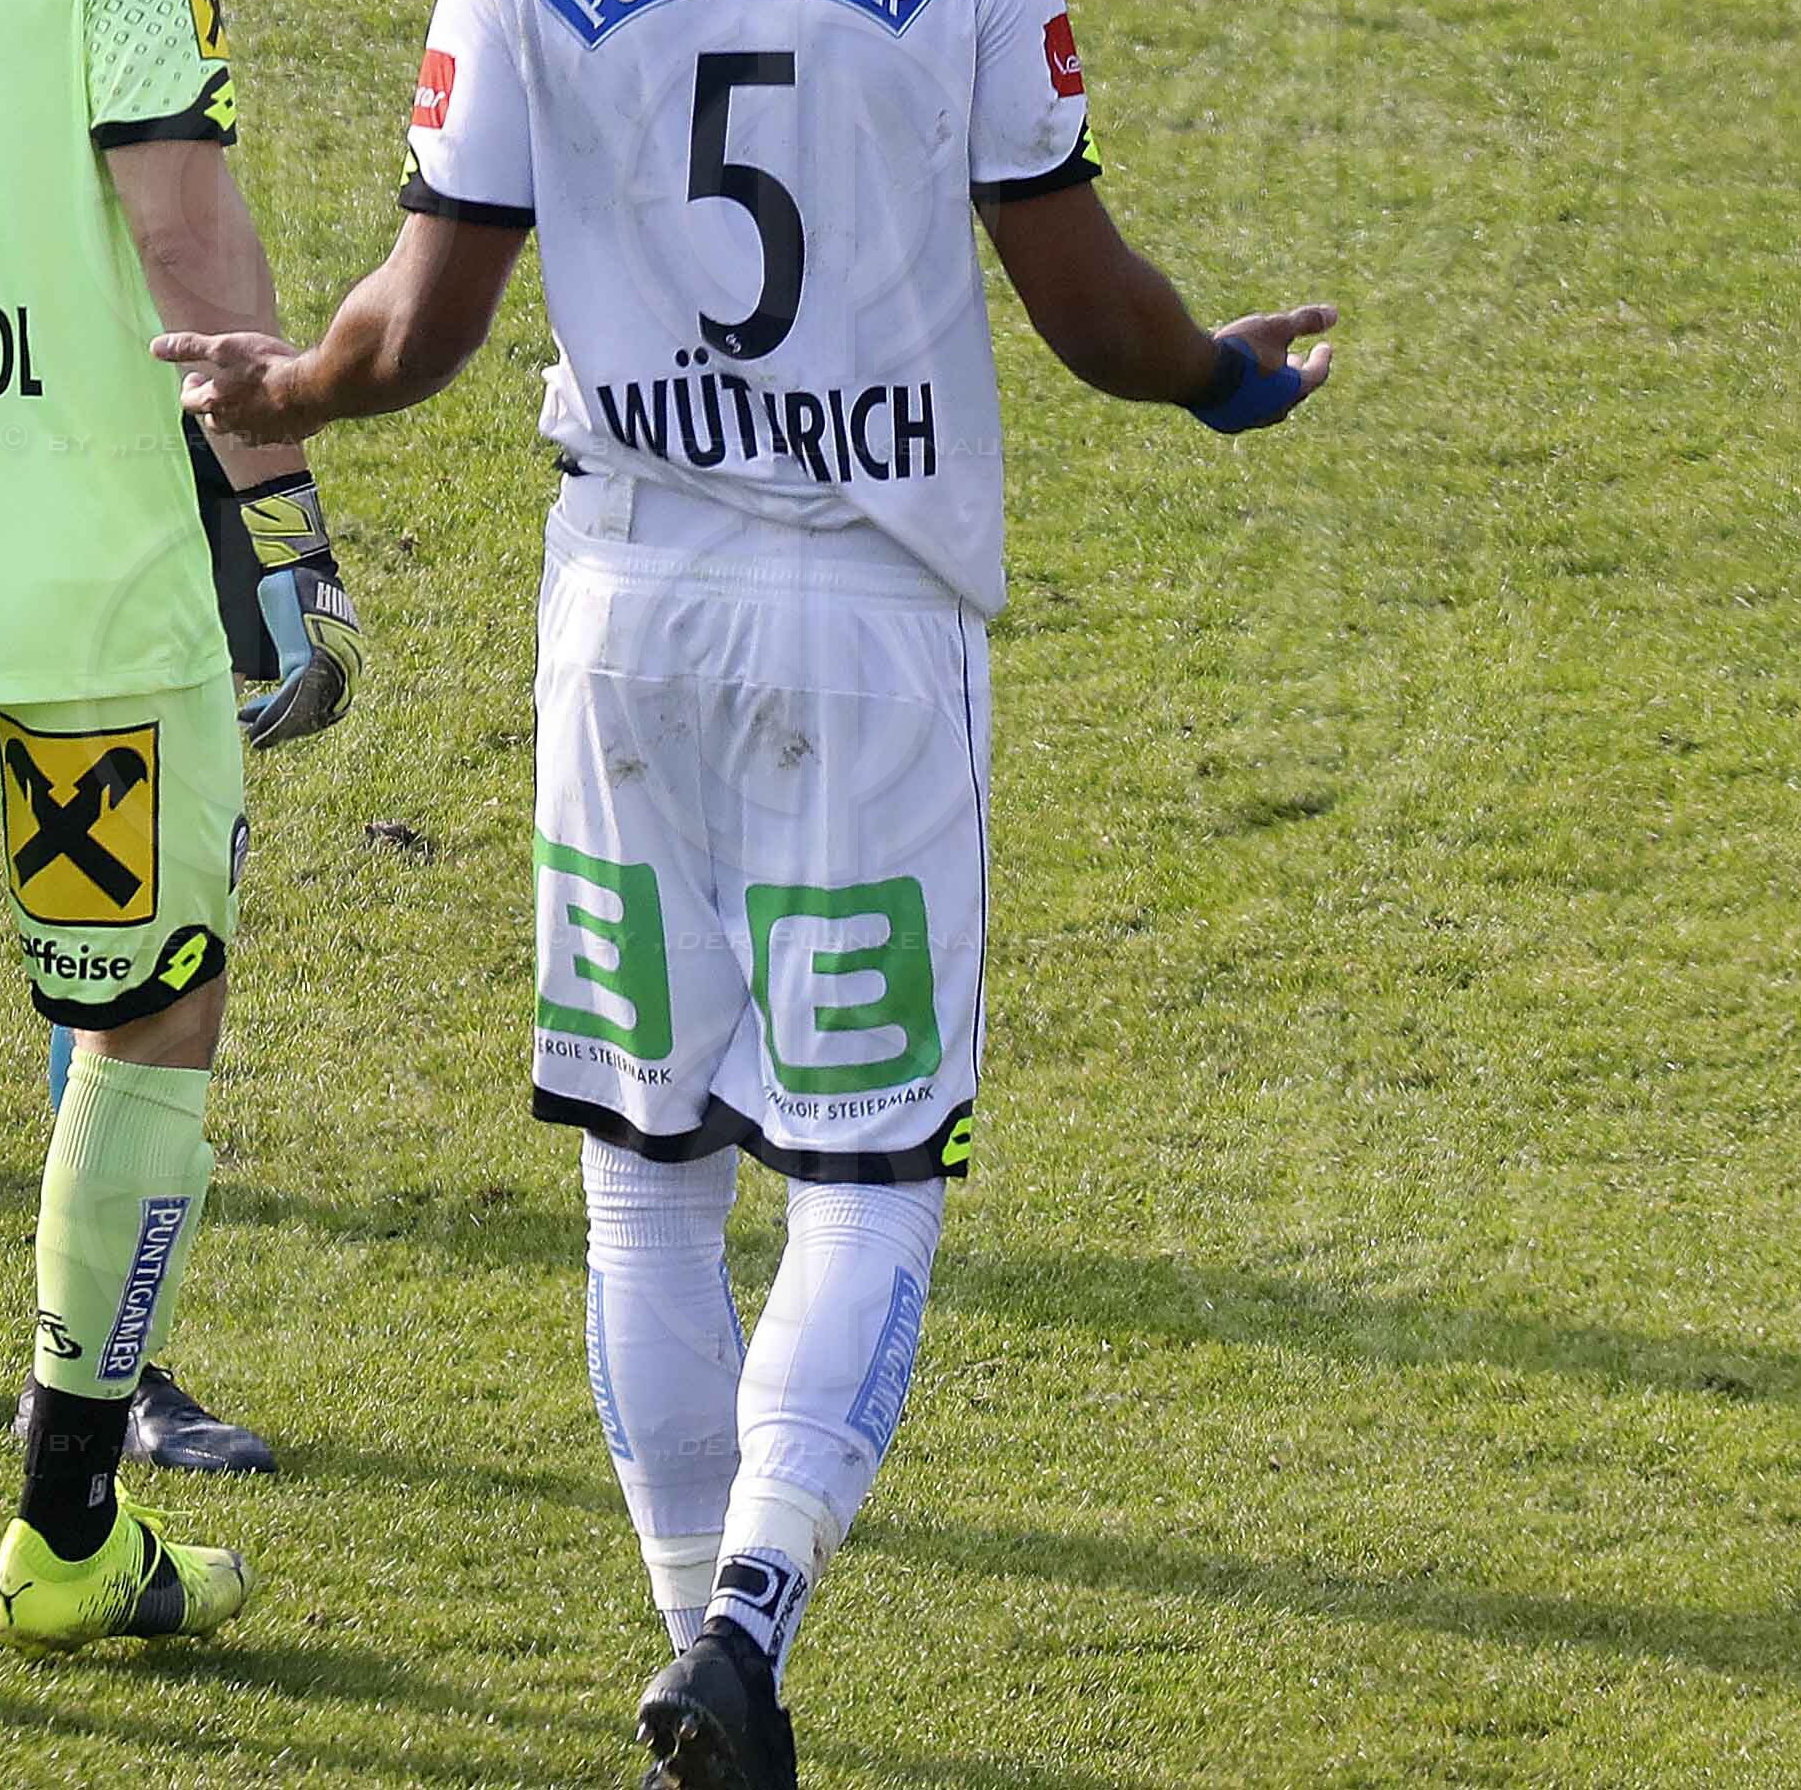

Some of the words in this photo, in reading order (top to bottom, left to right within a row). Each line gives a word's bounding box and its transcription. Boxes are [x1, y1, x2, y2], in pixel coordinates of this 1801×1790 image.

[686, 52, 805, 360] 5
[538, 1036, 583, 1060] ERGIE
[827, 1083, 935, 1121] STEIERMARK
[107, 1209, 183, 1372] PUNTIGAMER
